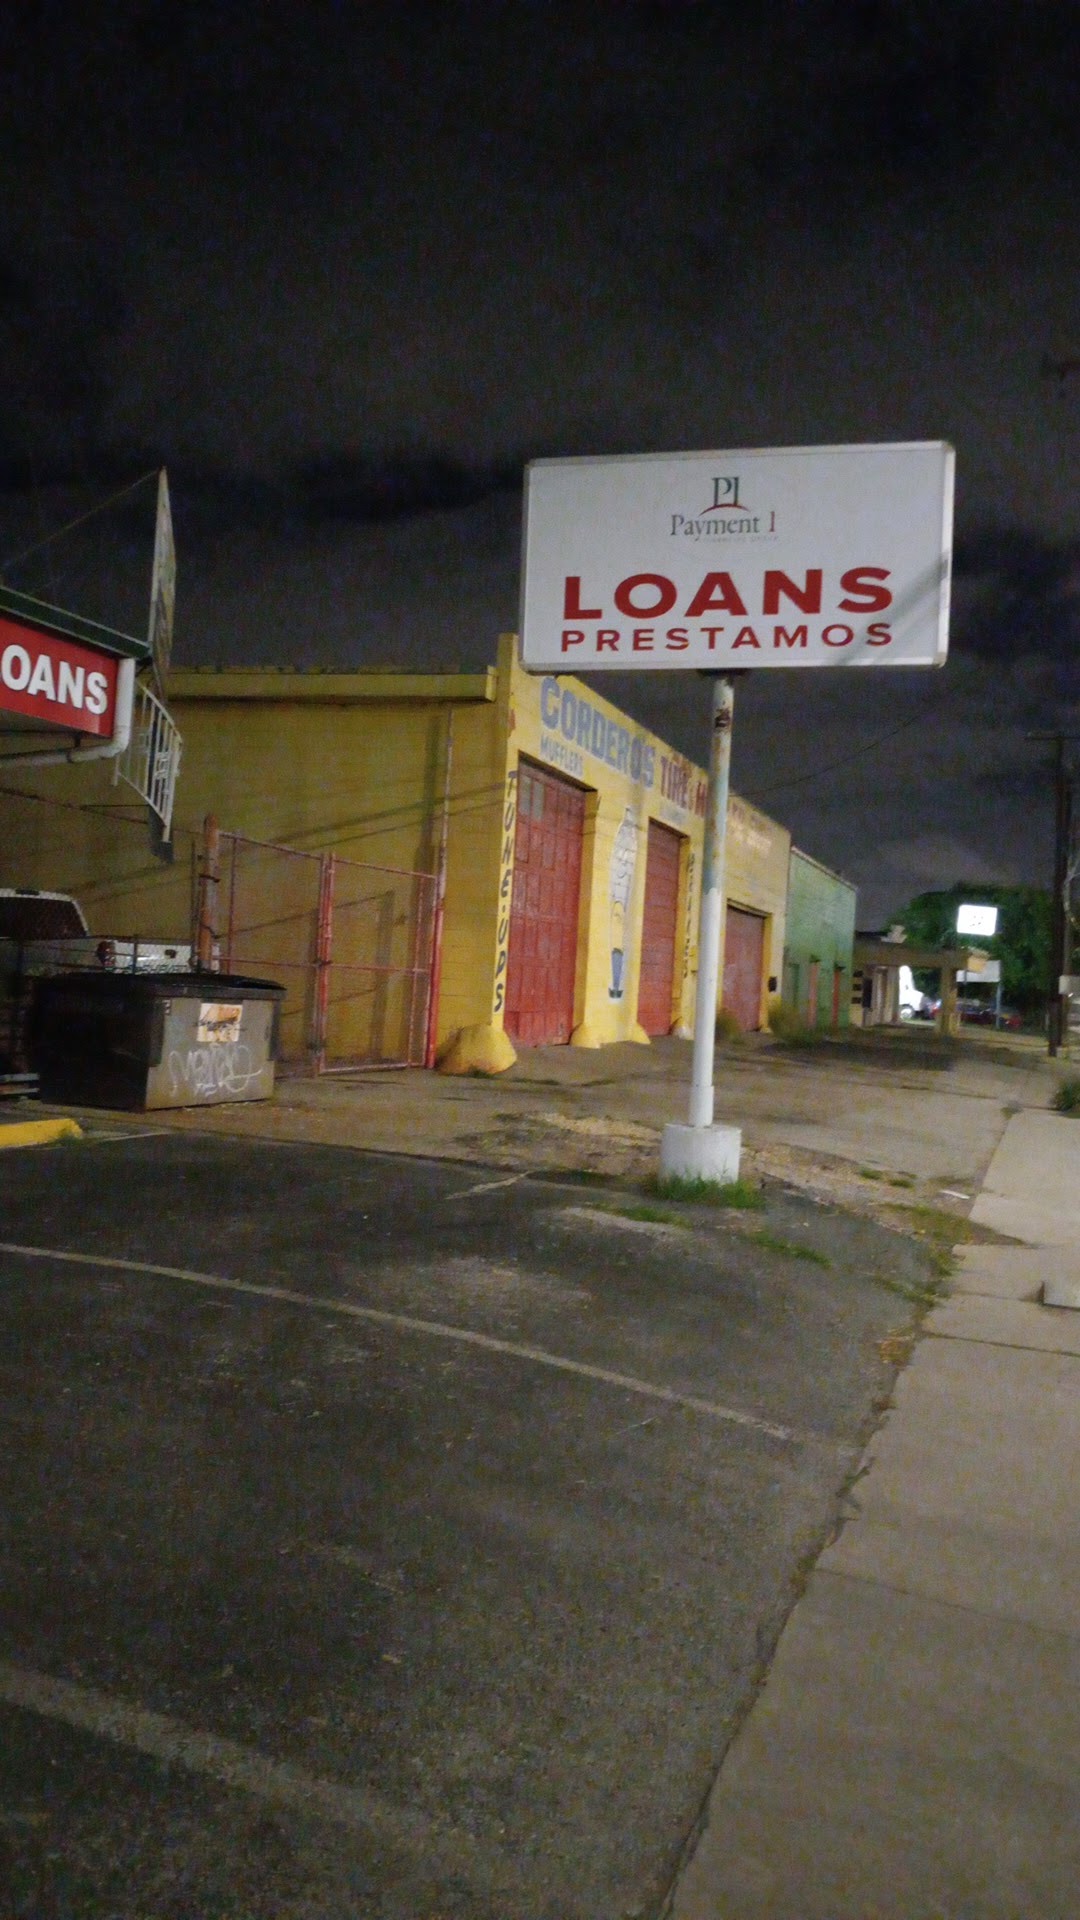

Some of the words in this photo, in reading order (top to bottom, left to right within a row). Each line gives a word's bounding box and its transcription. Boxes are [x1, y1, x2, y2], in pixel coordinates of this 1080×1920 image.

[670, 514, 760, 541] Payment
[769, 511, 776, 533] 1
[563, 567, 893, 620] LOANS
[561, 623, 892, 652] PRESTAMOS
[1, 644, 108, 715] OANS
